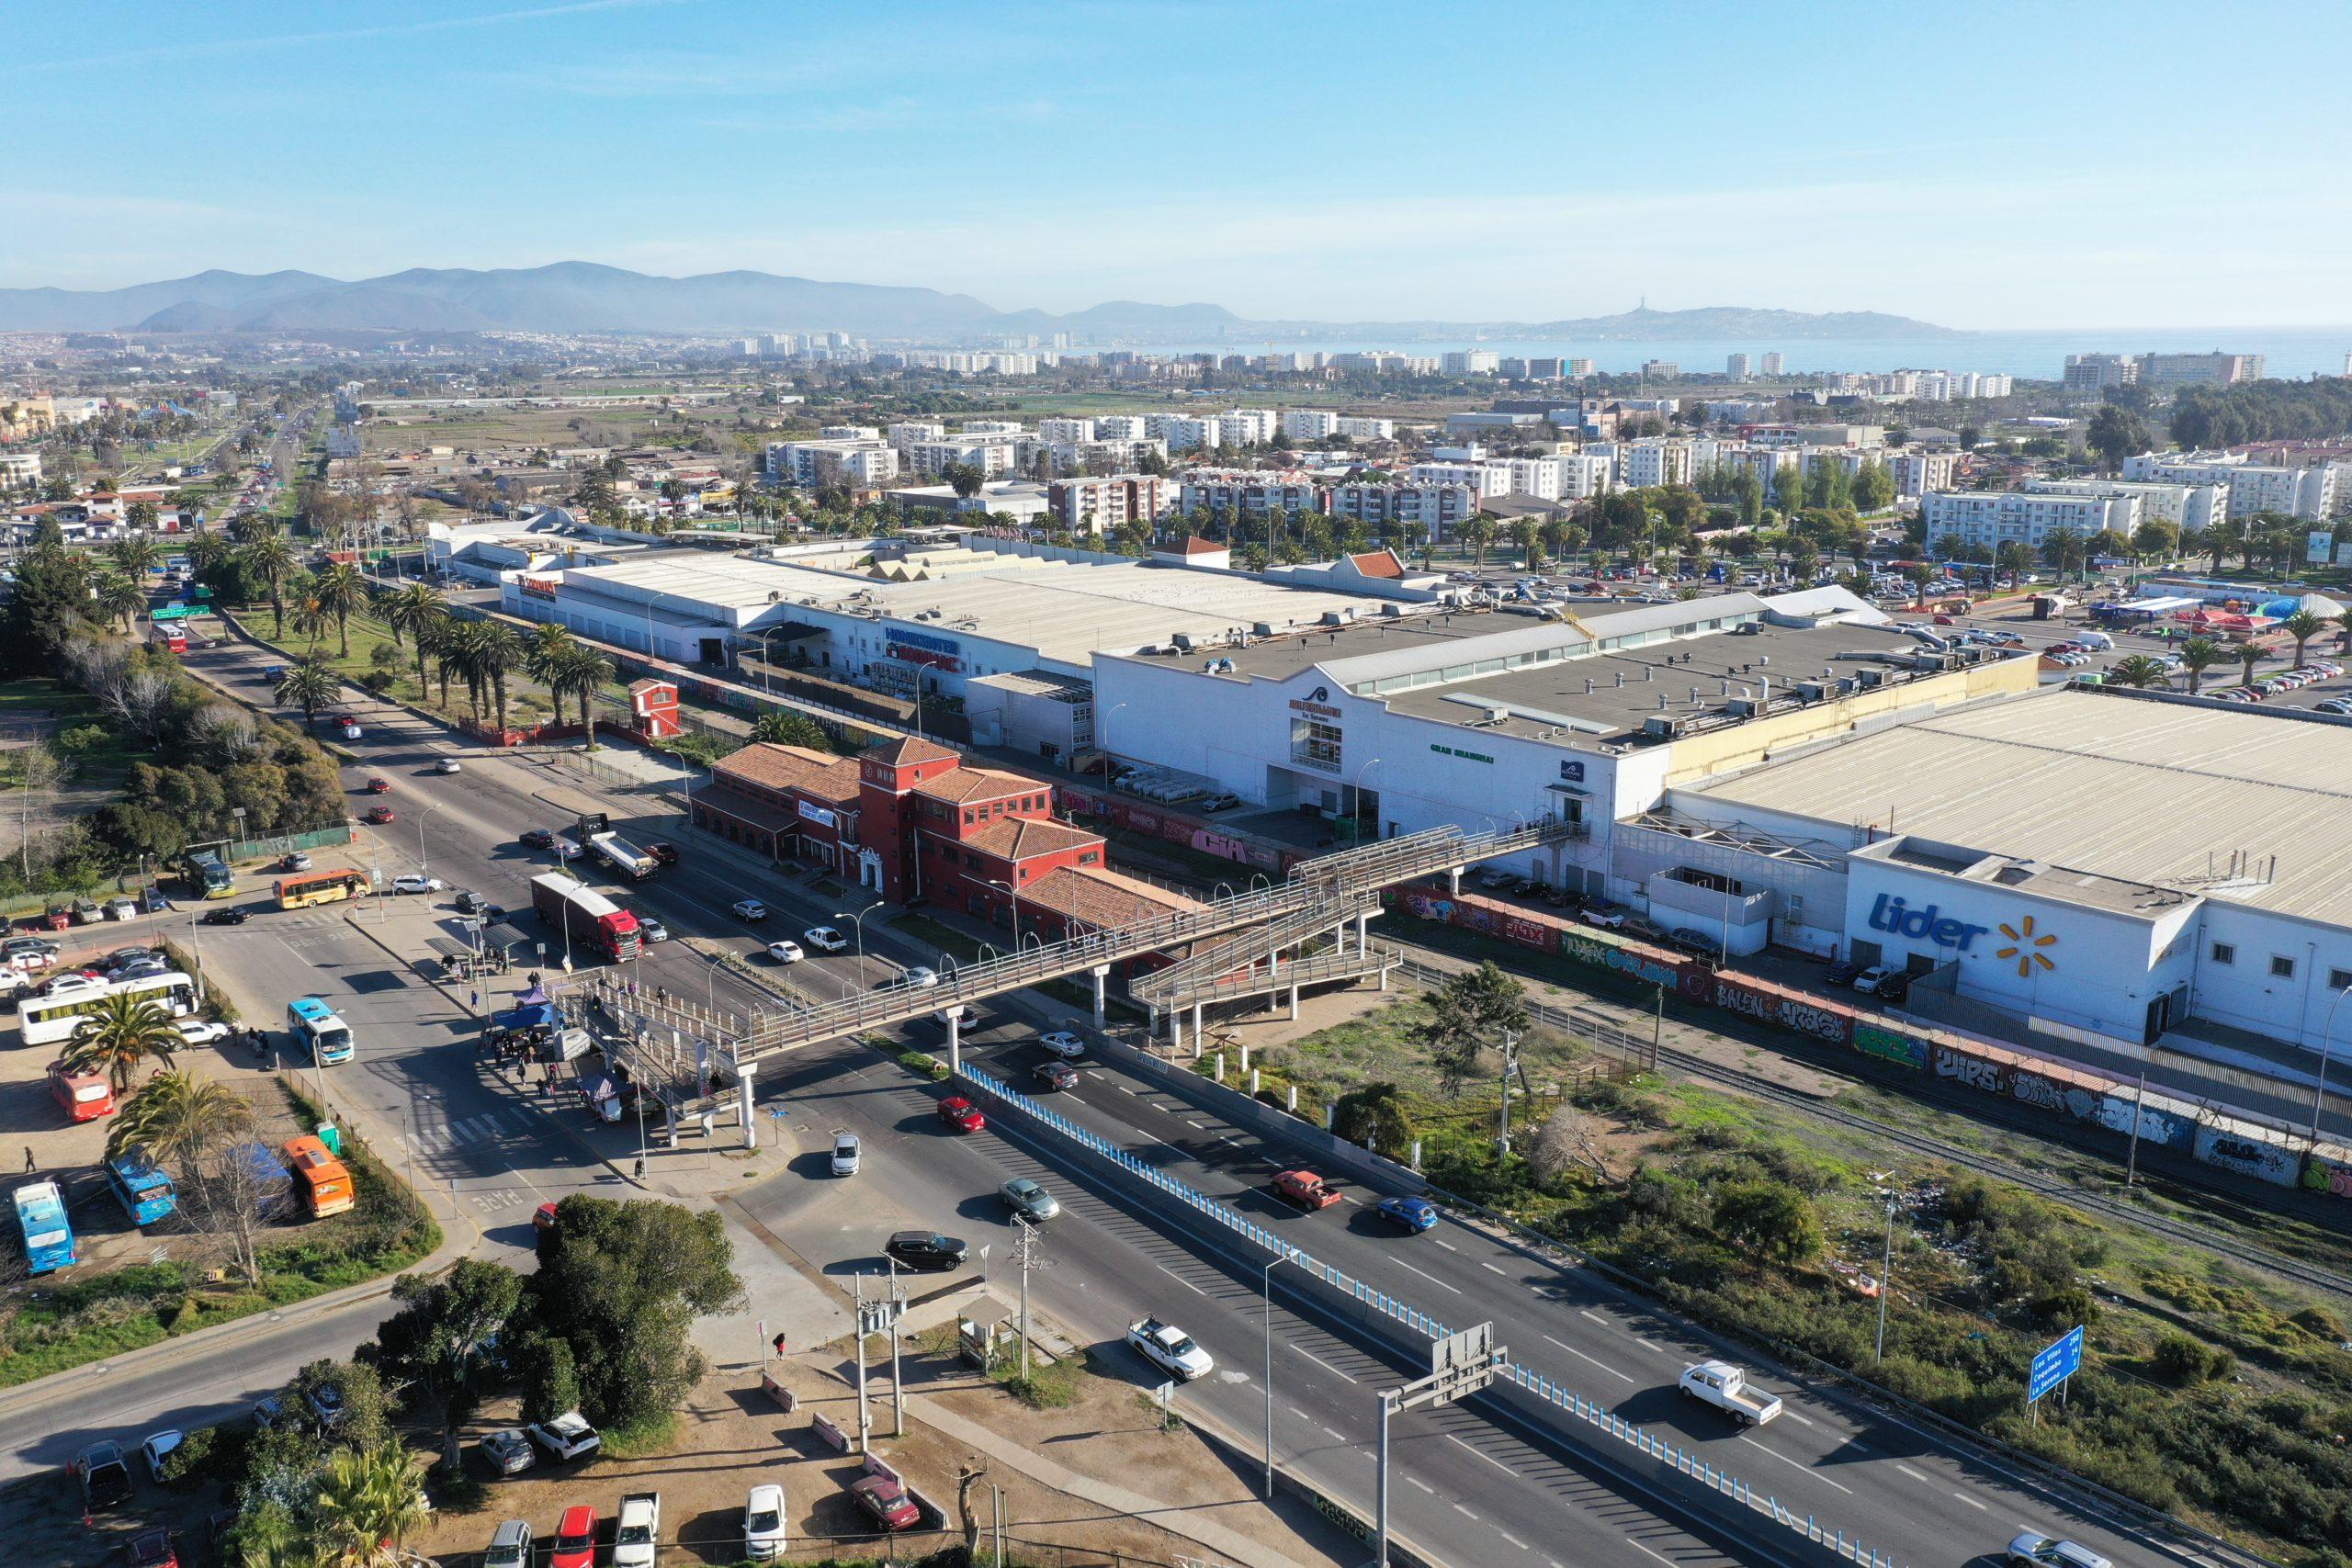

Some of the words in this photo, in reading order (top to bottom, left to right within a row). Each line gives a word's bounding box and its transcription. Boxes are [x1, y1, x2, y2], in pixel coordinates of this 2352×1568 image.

[886, 627, 960, 655] HOMECENTER
[899, 644, 960, 672] SODIMAC
[1454, 750, 1494, 764] SHANGHAI
[2033, 1359, 2062, 1382] Coquimbo
[2041, 1371, 2060, 1389] Serena
